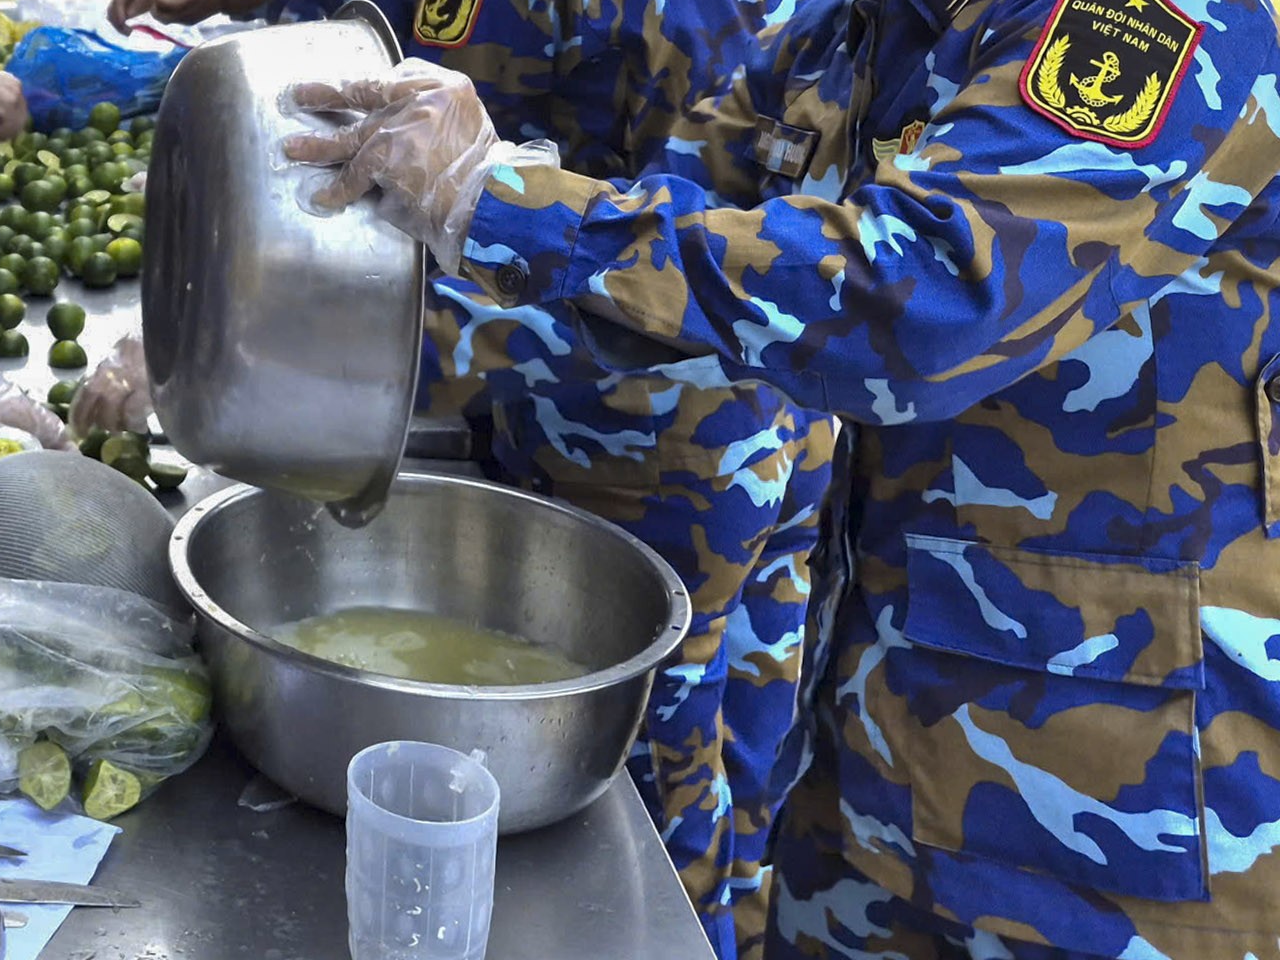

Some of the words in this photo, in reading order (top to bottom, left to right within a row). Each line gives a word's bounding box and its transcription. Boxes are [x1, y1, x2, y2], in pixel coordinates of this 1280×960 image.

[1071, 0, 1105, 16] QUÂN
[1106, 9, 1127, 24] ĐỘI
[1127, 17, 1158, 39] NHÂN
[1157, 32, 1179, 53] DÂN
[1092, 20, 1121, 37] VIỆT
[1122, 33, 1150, 53] NAM
